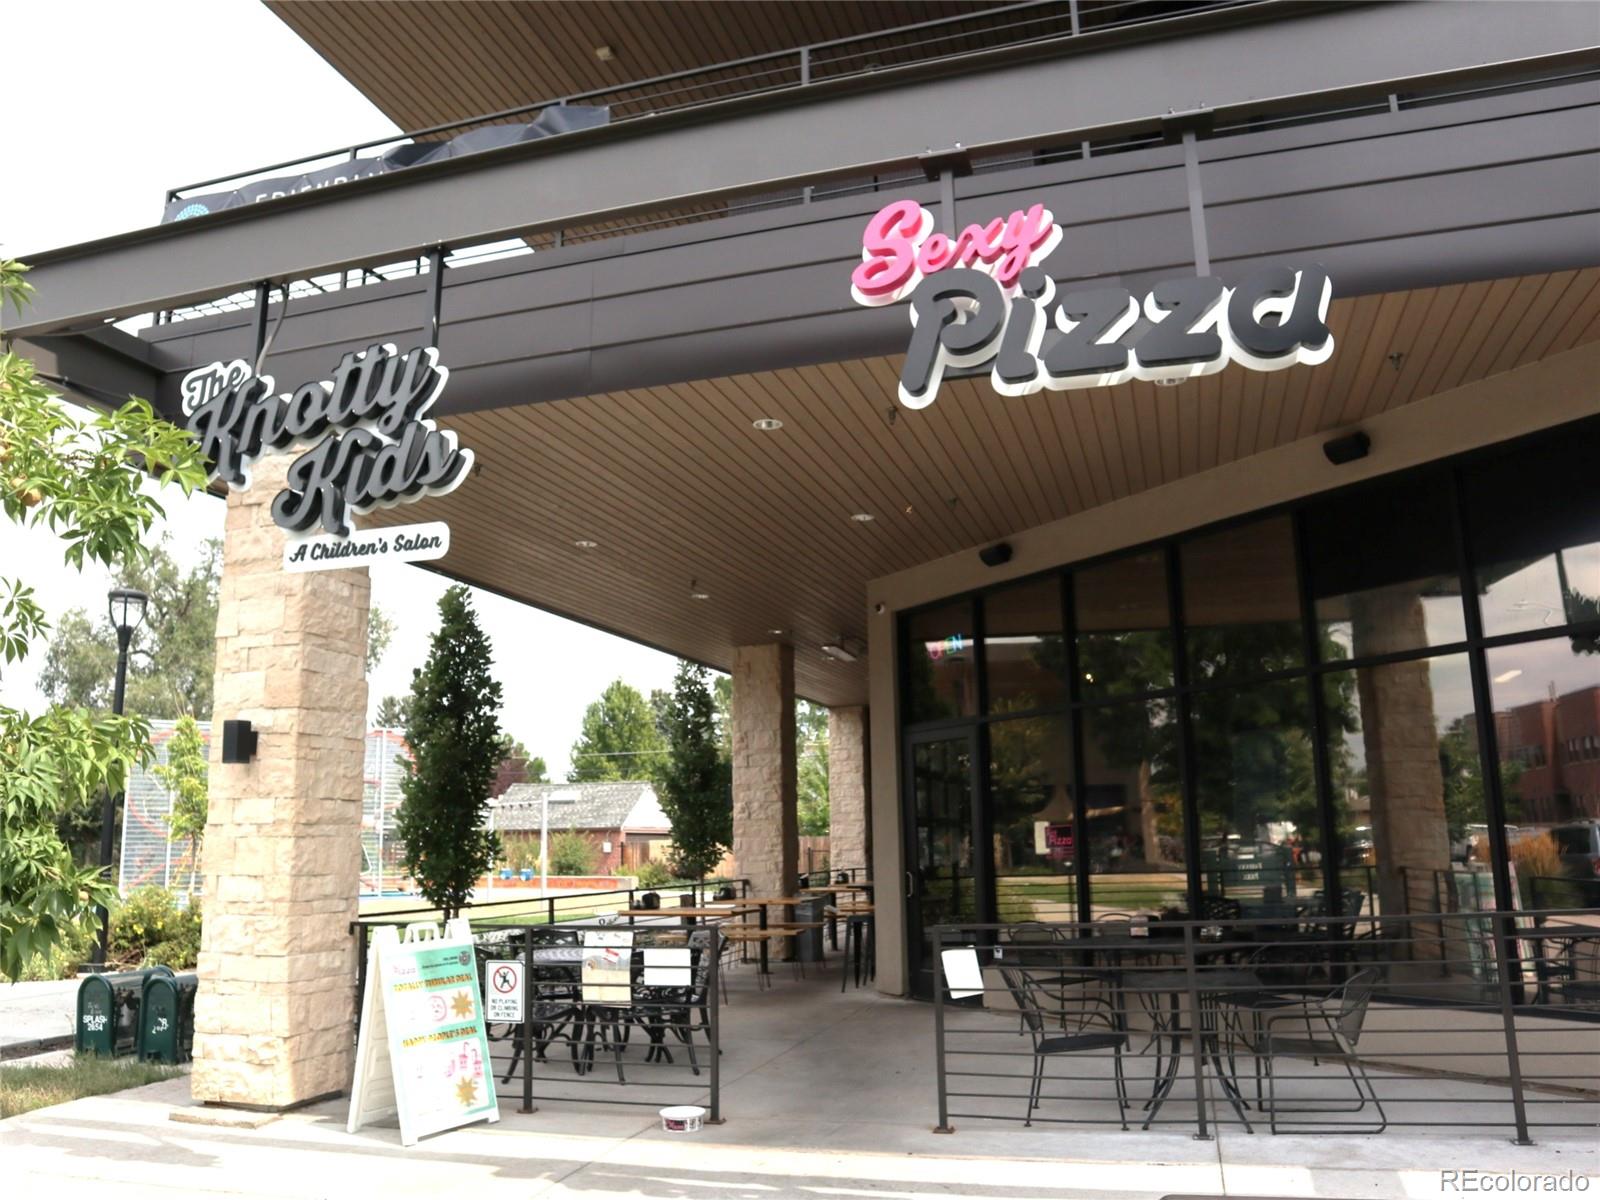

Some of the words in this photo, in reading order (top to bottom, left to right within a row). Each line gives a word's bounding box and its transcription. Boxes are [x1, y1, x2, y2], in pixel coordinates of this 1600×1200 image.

[851, 199, 1054, 297] Sexy
[899, 262, 1333, 402] Pizza
[185, 364, 247, 412] The
[187, 343, 442, 487] Knotty
[271, 420, 466, 537] Kids
[289, 544, 306, 562] A
[310, 538, 388, 560] Children's
[393, 533, 442, 553] Salon
